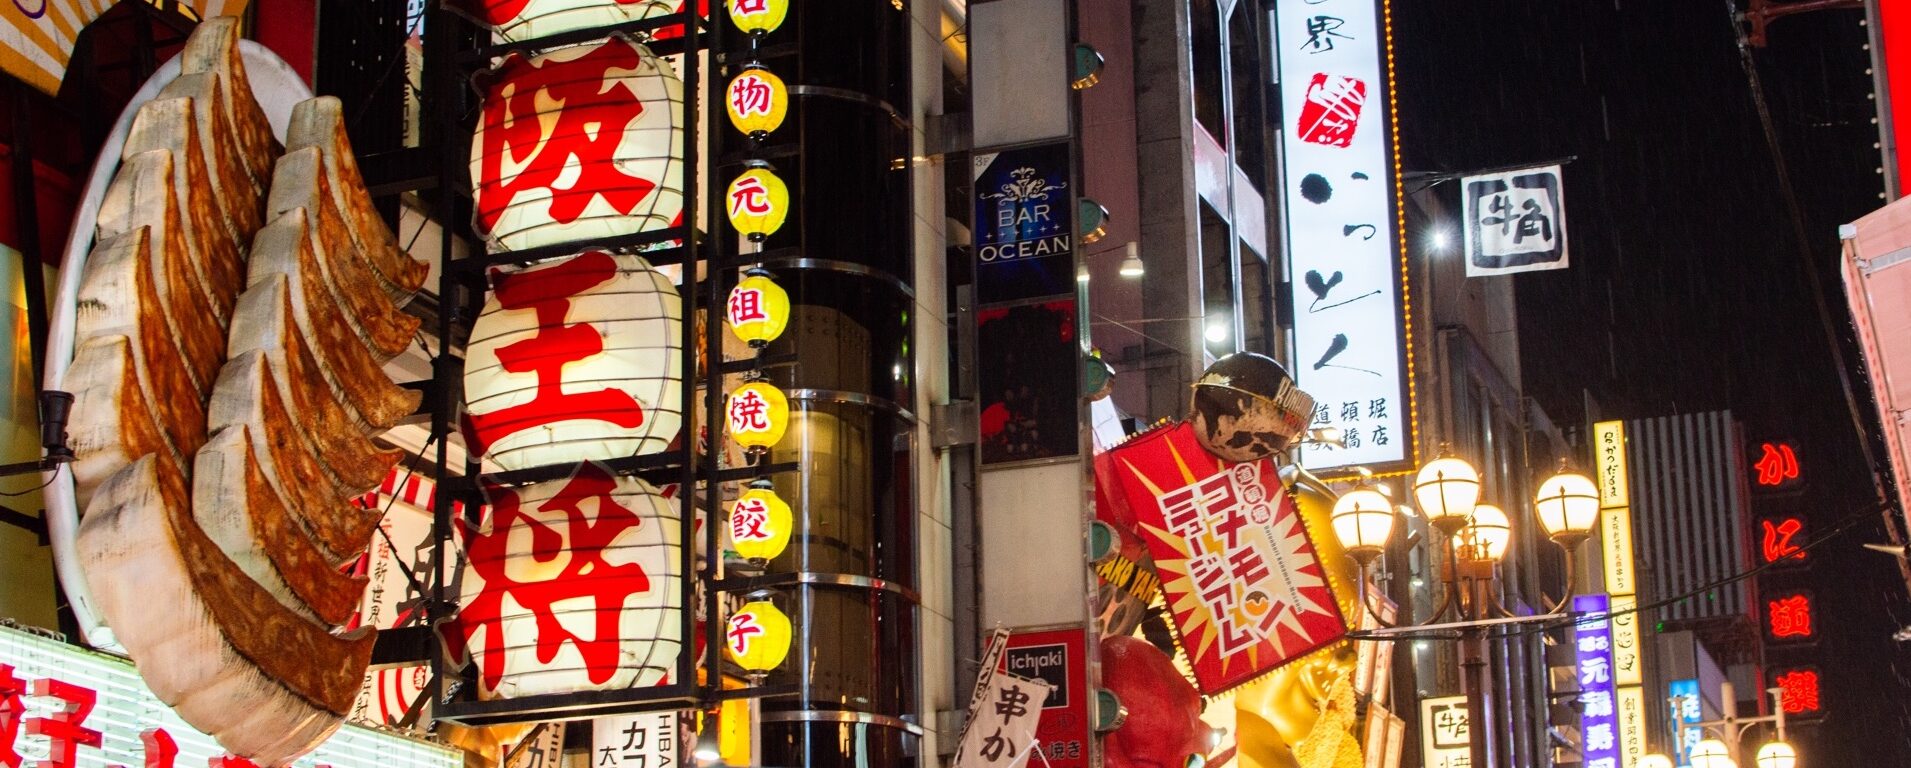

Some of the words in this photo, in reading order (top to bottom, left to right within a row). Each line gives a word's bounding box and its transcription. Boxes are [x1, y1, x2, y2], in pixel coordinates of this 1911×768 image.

[998, 204, 1050, 228] BAR
[1481, 194, 1553, 245] 牛角
[980, 235, 1070, 262] OCEAN
[1162, 488, 1255, 654] ミュージアム
